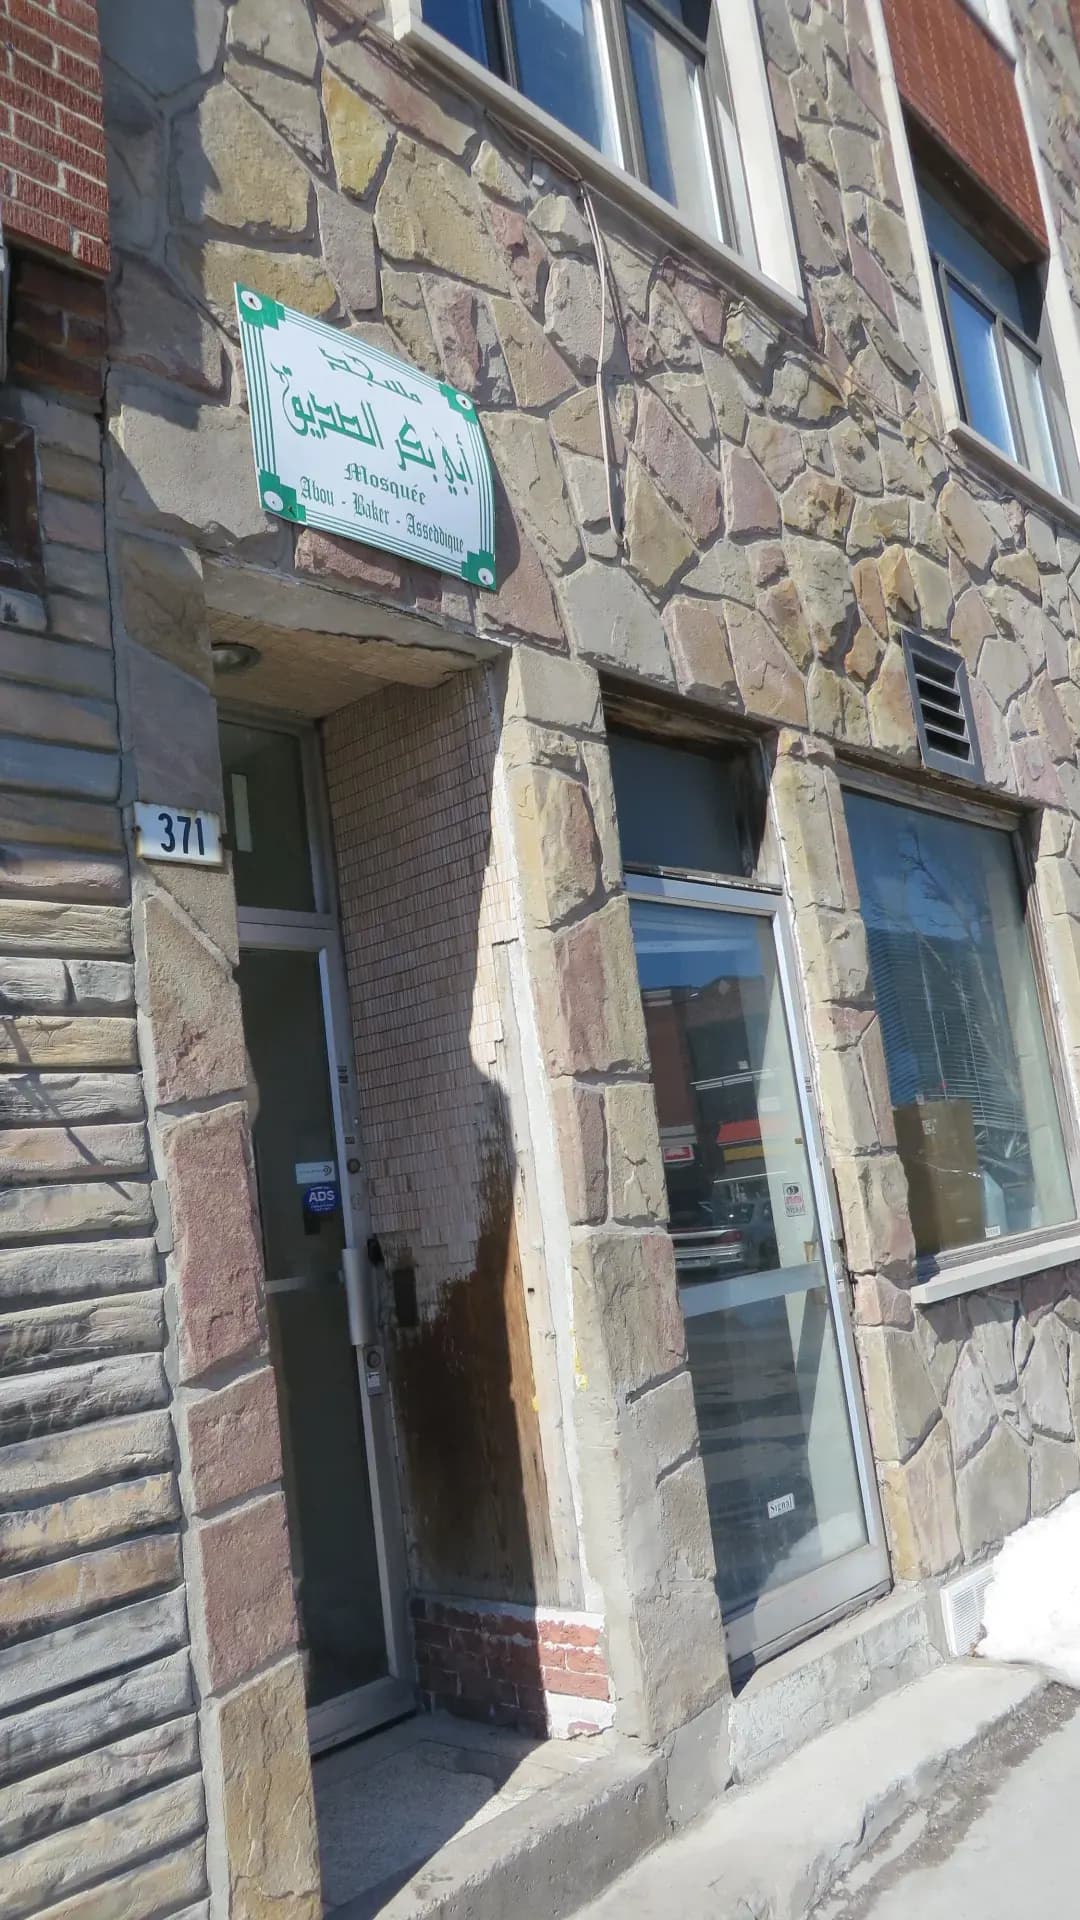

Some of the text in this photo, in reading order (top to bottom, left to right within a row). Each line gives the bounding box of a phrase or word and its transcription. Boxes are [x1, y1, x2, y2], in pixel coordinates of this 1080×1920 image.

[318, 347, 422, 404] مسجد
[395, 414, 436, 483] بكر
[432, 427, 473, 496] أبي
[344, 463, 425, 505] Mosquée
[300, 475, 334, 507] Abou
[352, 491, 389, 525] Baker
[406, 512, 464, 554] Asseddique
[158, 812, 205, 856] 371
[308, 1190, 336, 1203] ADS
